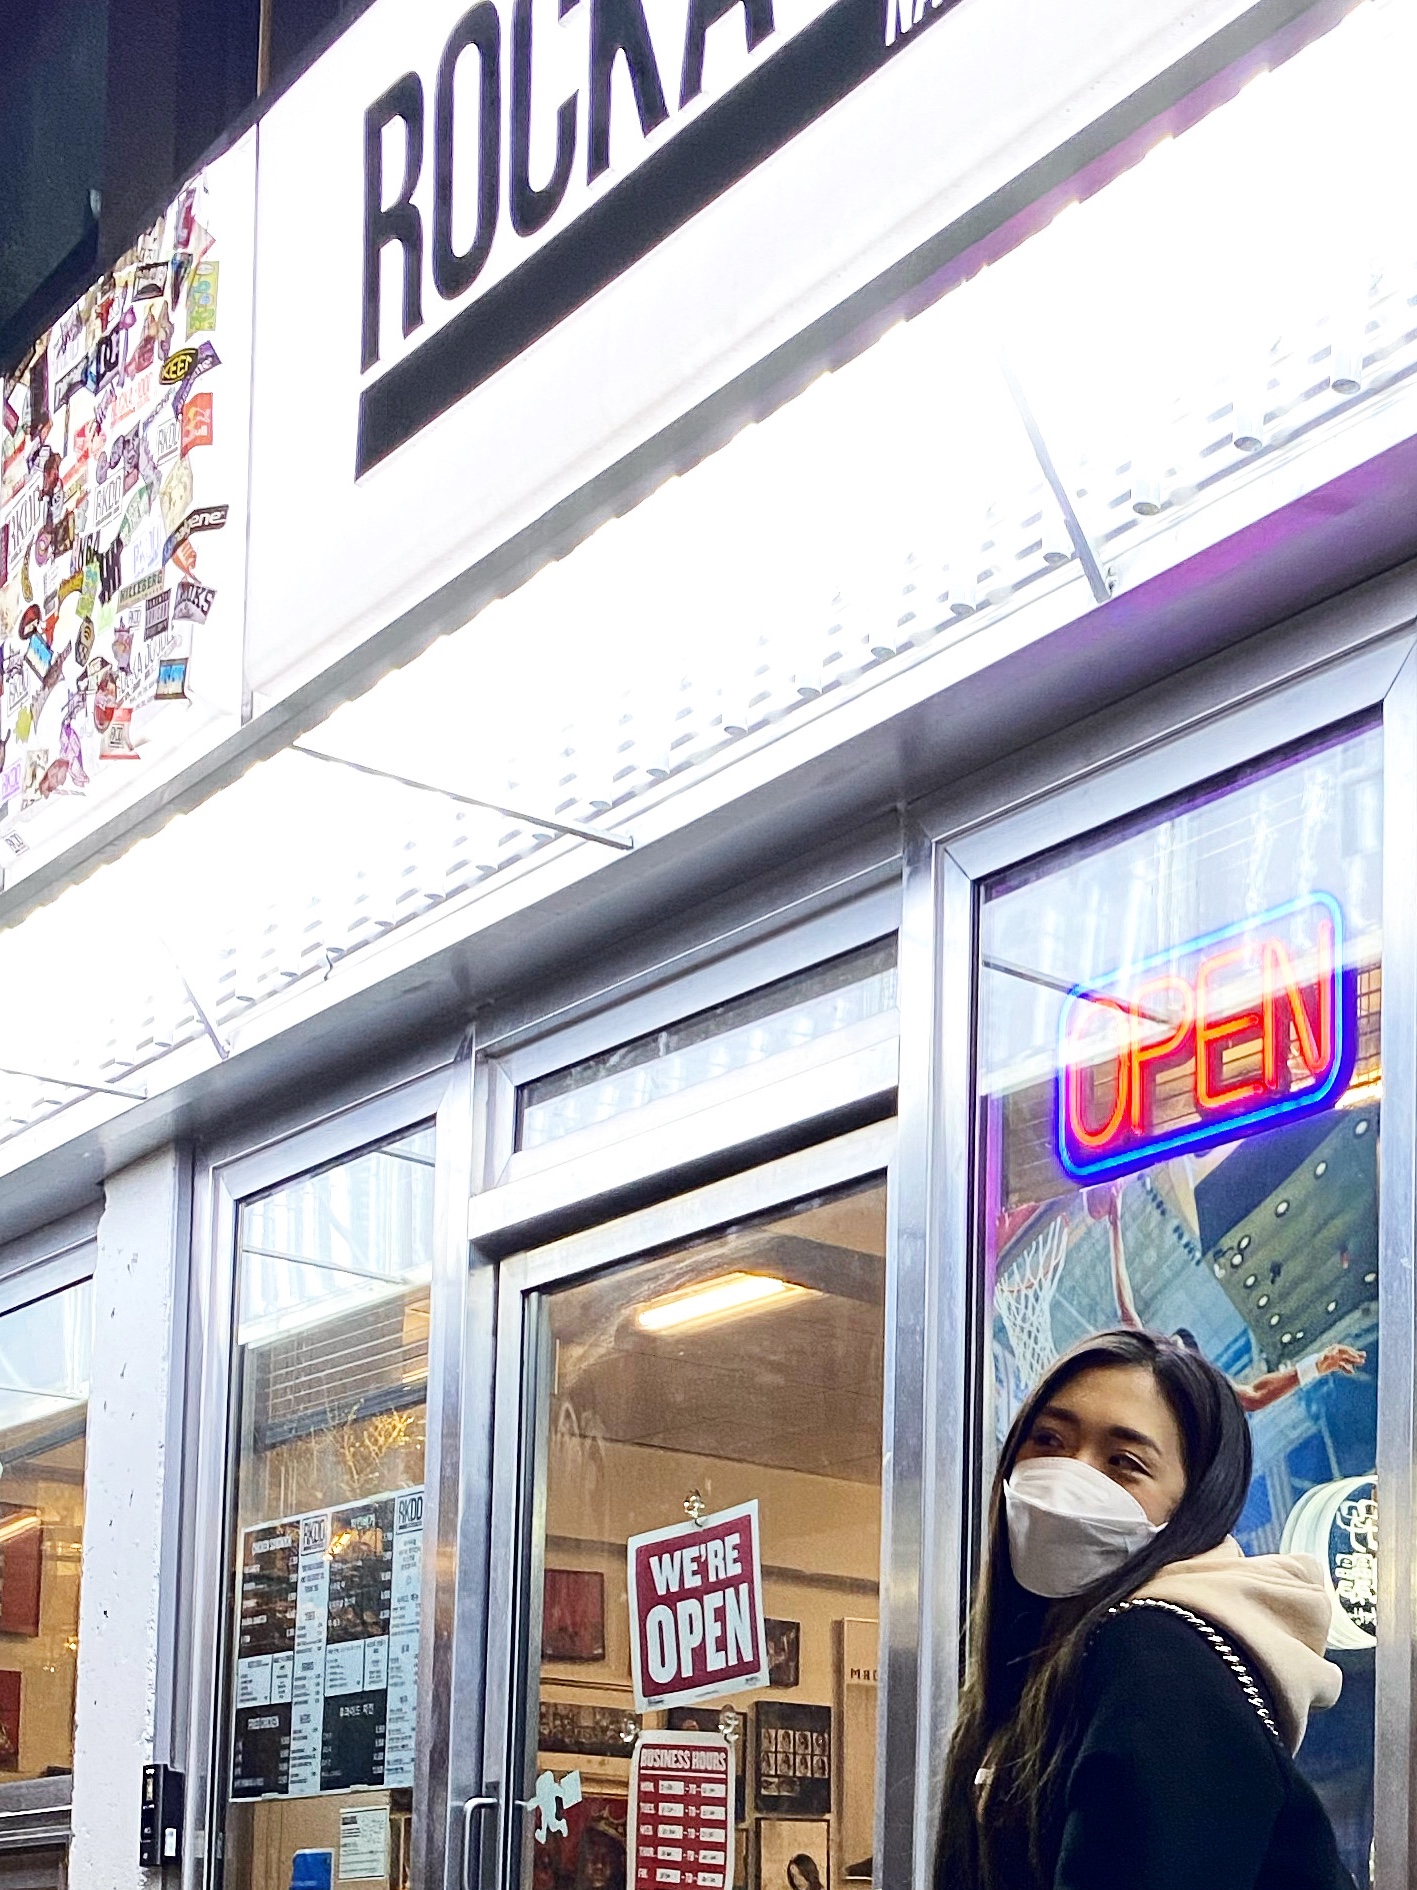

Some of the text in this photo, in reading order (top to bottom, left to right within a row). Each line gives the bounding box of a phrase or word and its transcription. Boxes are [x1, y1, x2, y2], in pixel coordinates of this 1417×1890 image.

[1068, 916, 1334, 1150] OPEN
[648, 1532, 743, 1597] WE'RE
[645, 1582, 755, 1685] OPEN
[640, 1748, 727, 1773] BUSINESS HOURS
